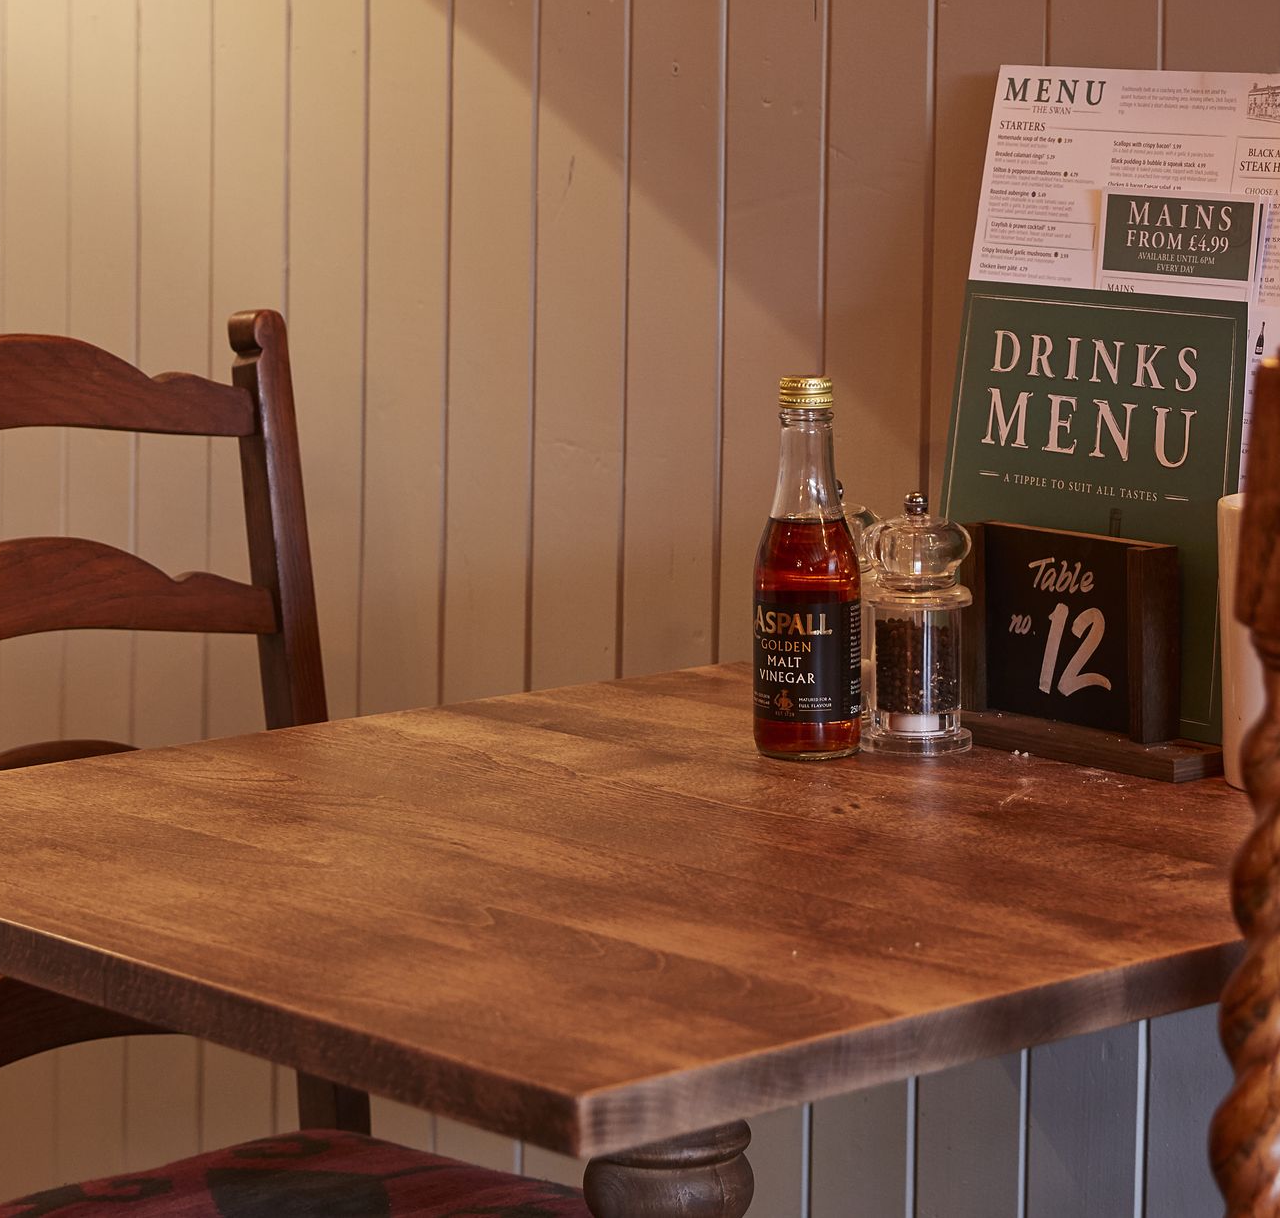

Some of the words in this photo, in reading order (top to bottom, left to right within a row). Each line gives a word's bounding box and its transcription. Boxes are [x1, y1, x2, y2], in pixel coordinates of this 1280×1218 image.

[1003, 77, 1107, 106] MENU
[1032, 105, 1048, 114] THE
[1048, 106, 1072, 115] SWAN
[1000, 120, 1046, 132] STARTERS
[1113, 140, 1132, 148] Scallops
[1142, 142, 1155, 150] crispy
[1248, 148, 1274, 158] BLACK
[1124, 158, 1142, 166] pudding
[1240, 161, 1272, 172] STEAK
[990, 188, 1008, 196] Roasted
[1244, 187, 1274, 196] CHOOSE
[1274, 188, 1278, 196] A
[1126, 200, 1233, 232] MAINS
[1126, 229, 1183, 250] FROM
[1188, 234, 1230, 254] £4.99
[982, 246, 995, 254] Crispy
[1026, 250, 1052, 258] mushrooms
[1138, 251, 1176, 262] AVAILABLE
[1176, 254, 1200, 264] UNTIL
[1200, 256, 1216, 265] 6PM
[980, 262, 996, 270] Chicken
[1156, 264, 1180, 272] EVERY
[1180, 265, 1195, 274] DAY
[1106, 283, 1135, 293] MAINS
[990, 329, 1198, 392] DRINKS
[981, 387, 1198, 468] MENU
[1003, 473, 1010, 483] A
[1013, 474, 1047, 488] TIPPLE
[1050, 479, 1065, 490] TO
[1068, 481, 1092, 494] SUIT
[1096, 485, 1116, 497] ALL
[1119, 488, 1158, 502] TASTES
[1028, 556, 1095, 594] Table
[753, 604, 833, 639] ASPALL
[761, 638, 812, 653] GOLDEN
[1007, 612, 1037, 636] no.
[1038, 602, 1112, 697] 12
[767, 654, 802, 668] MALT
[759, 668, 816, 684] VINEGAR
